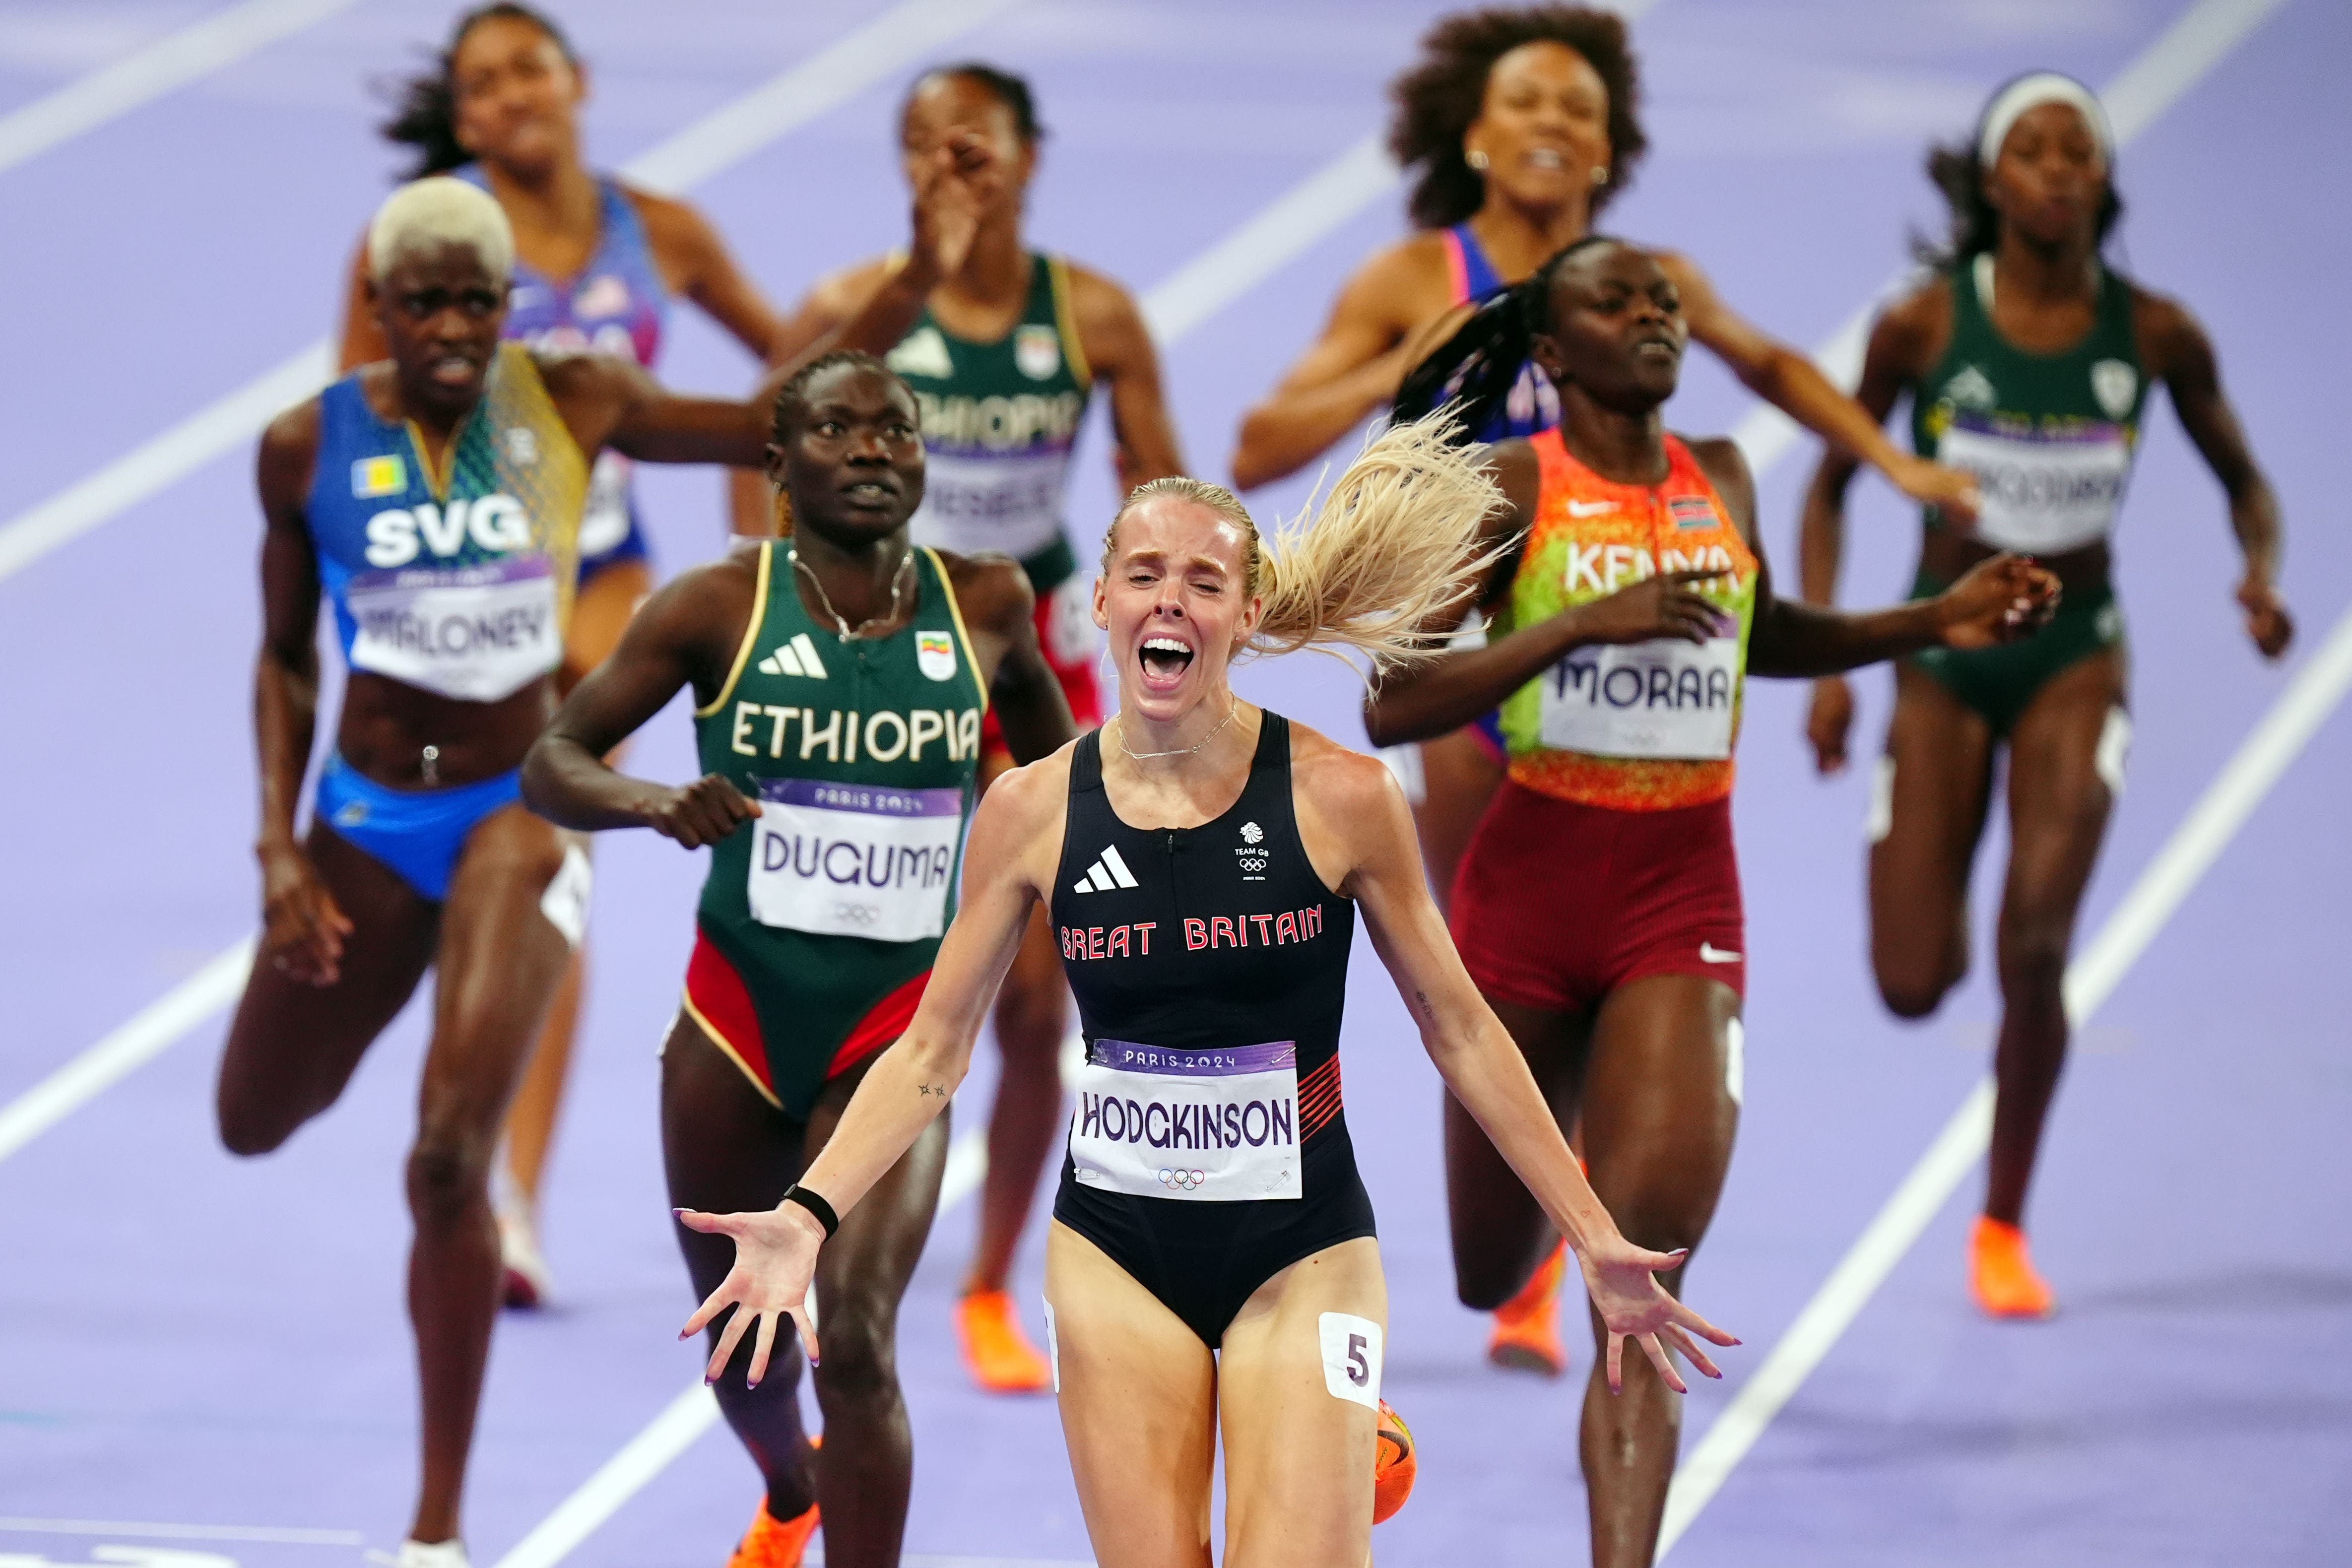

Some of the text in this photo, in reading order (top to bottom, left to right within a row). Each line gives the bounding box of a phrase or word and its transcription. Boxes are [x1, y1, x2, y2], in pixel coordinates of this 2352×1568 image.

[366, 494, 530, 568] SVG
[1558, 658, 1728, 709] MORAA
[732, 700, 980, 763] ETHIOPIA
[763, 831, 949, 888] DUGUMA
[1258, 849, 1269, 857] GB
[1061, 904, 1322, 960] GREAT BRITAIN
[1185, 1055, 1235, 1067] 2024
[1081, 1091, 1292, 1150] HODGKINSON
[1347, 1333, 1369, 1387] 5
